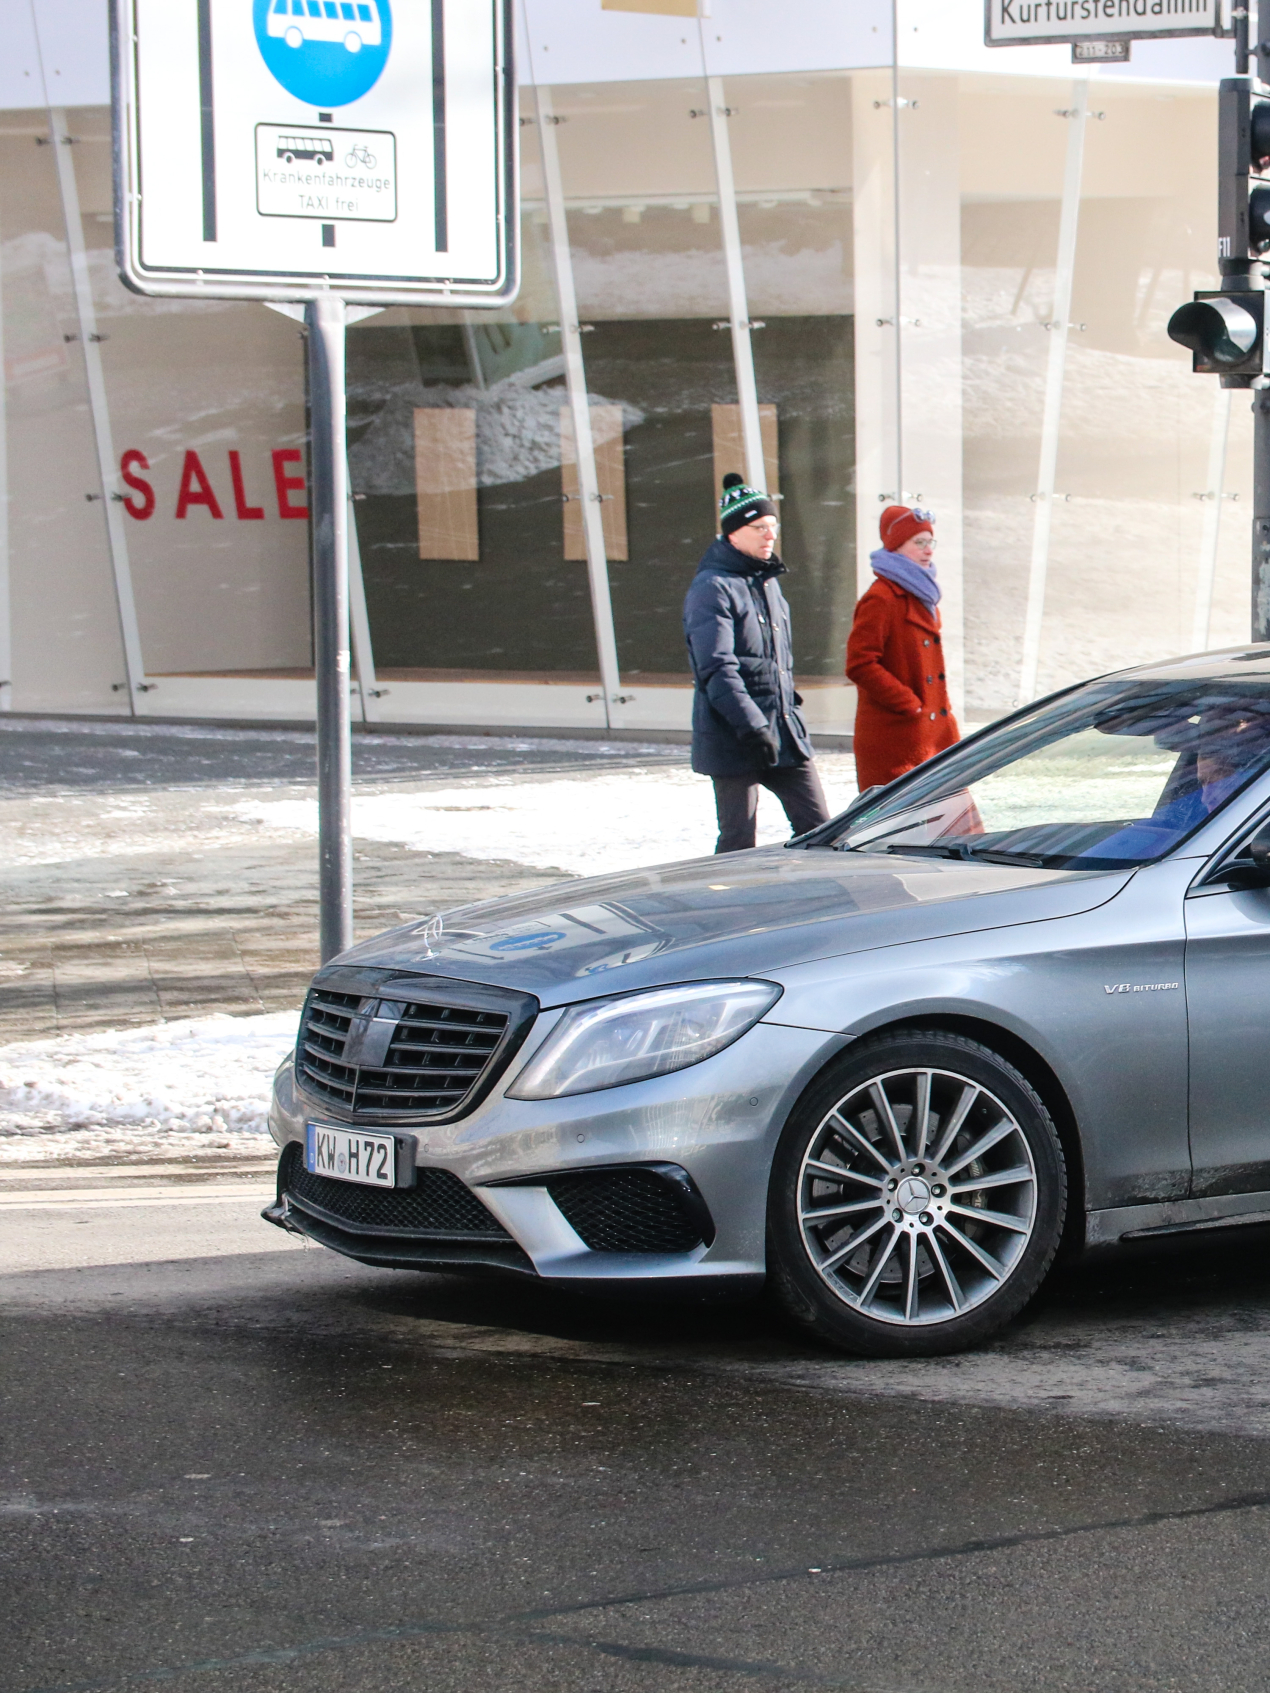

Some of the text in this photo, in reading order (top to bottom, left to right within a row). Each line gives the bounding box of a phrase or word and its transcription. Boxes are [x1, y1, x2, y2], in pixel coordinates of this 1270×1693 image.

[263, 169, 391, 193] Krankenfahrzeuge
[299, 194, 359, 212] TAXI frei
[121, 448, 309, 521] SALE
[1104, 982, 1179, 995] V8 BITURBO
